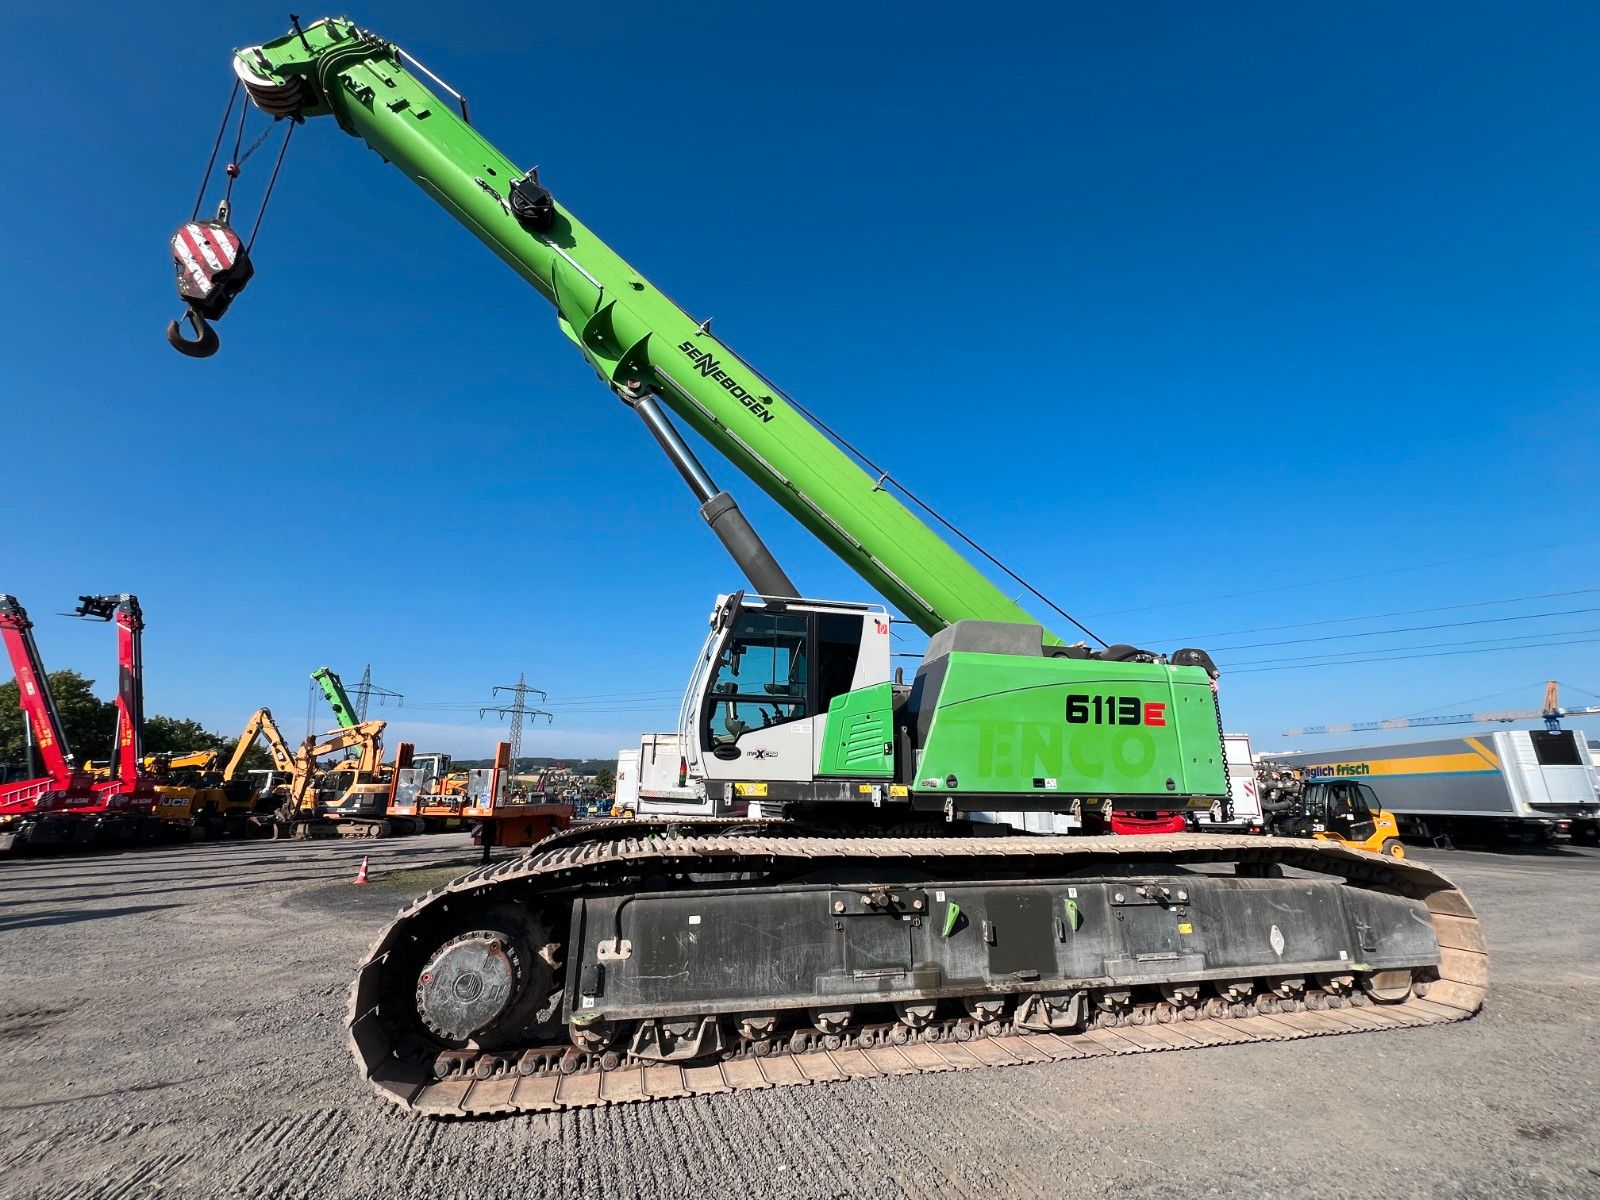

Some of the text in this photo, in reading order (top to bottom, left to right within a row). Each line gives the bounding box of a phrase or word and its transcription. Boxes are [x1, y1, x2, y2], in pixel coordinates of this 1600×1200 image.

[678, 341, 774, 423] SENNEBOGEN
[1336, 763, 1370, 775] frisch
[162, 798, 190, 806] JCB
